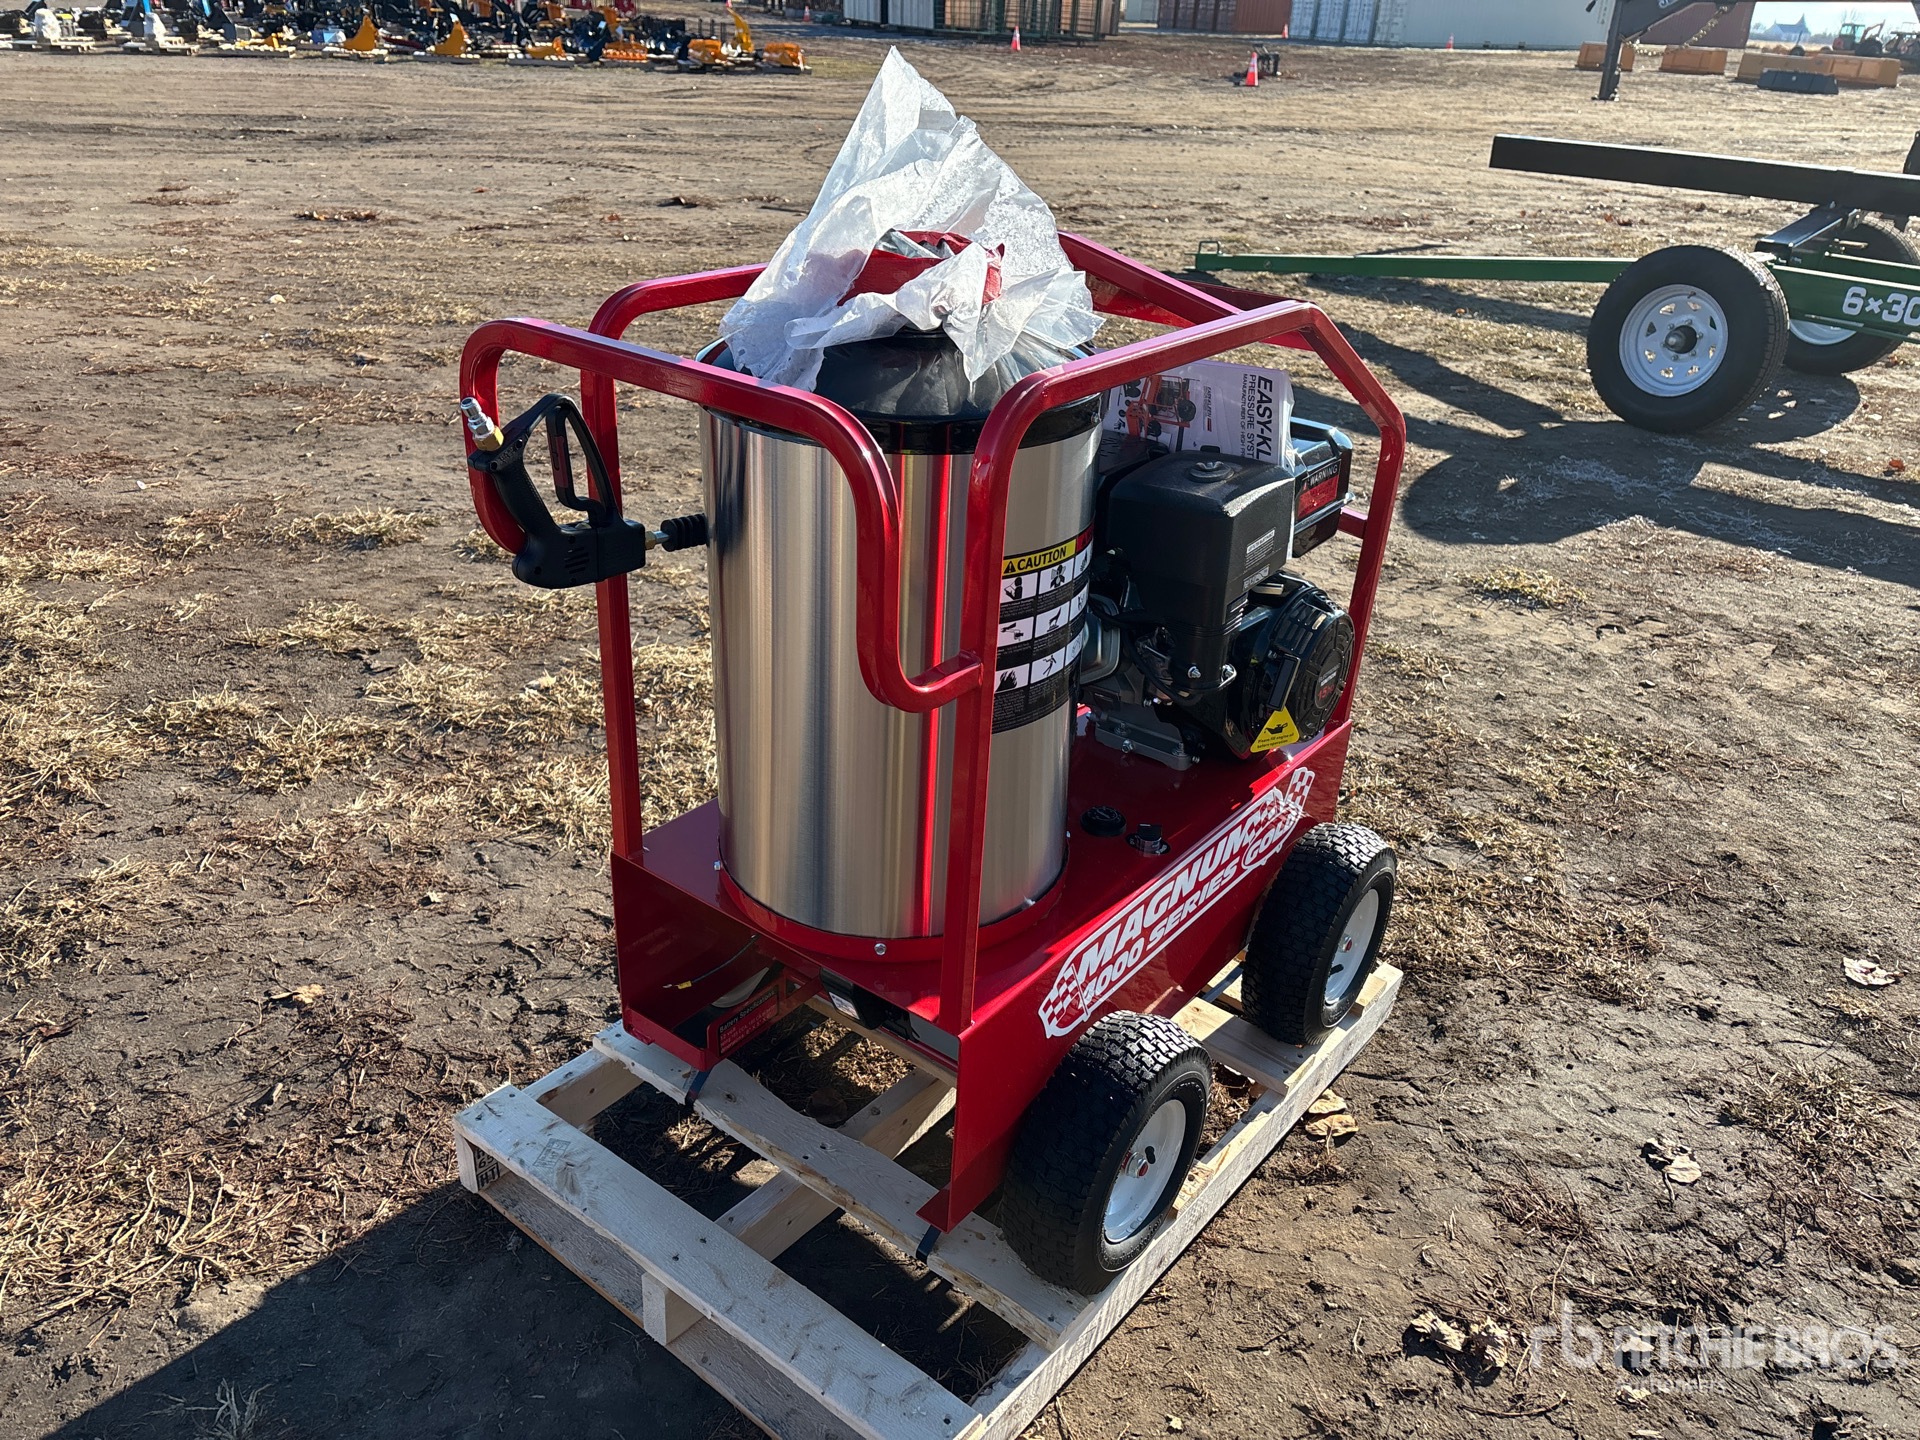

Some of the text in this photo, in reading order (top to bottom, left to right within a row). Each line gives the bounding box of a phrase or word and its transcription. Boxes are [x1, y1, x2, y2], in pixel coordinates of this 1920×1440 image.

[1240, 373, 1248, 420] MANUFACTURER
[1246, 374, 1257, 430] PRESSURE
[1240, 420, 1246, 431] OF
[1310, 464, 1338, 486] WARNING
[1017, 545, 1067, 571] CAUTION
[1076, 800, 1270, 985] MAGNUM
[1147, 856, 1240, 951] SERIES
[720, 1016, 738, 1033] Battery
